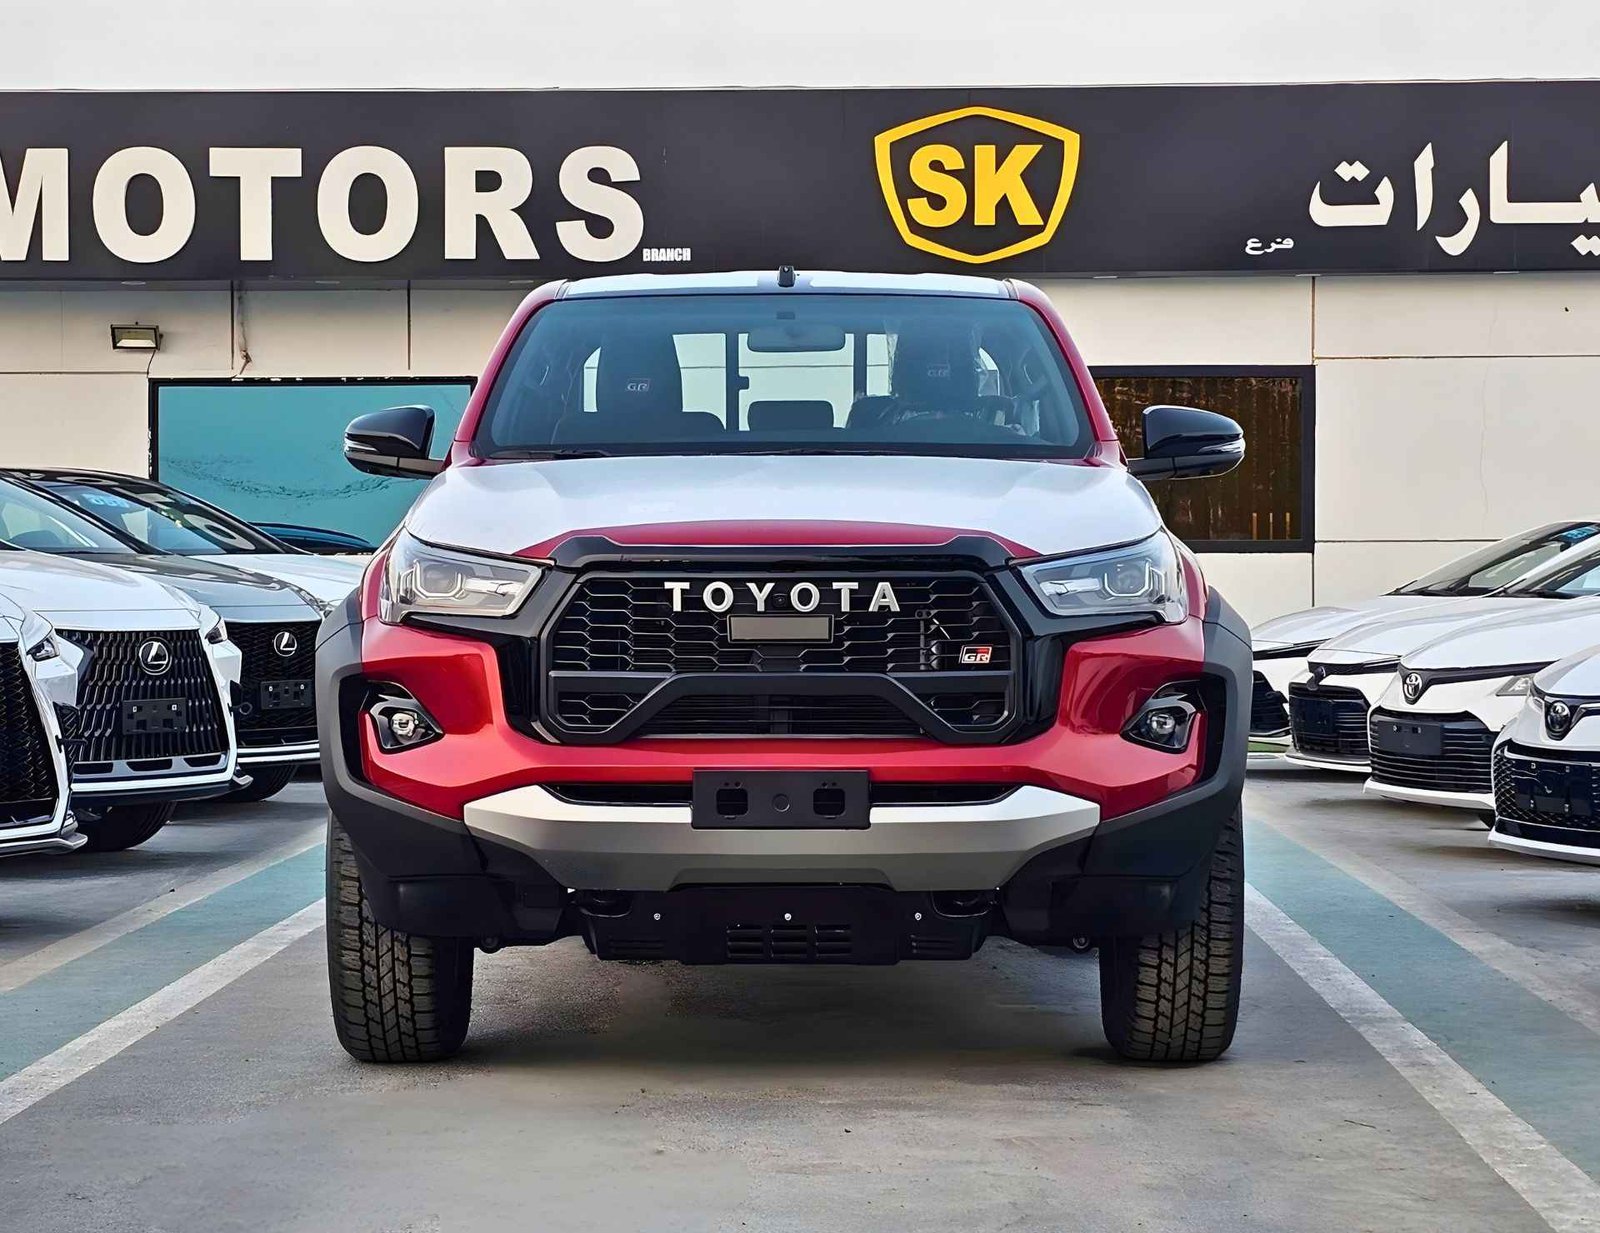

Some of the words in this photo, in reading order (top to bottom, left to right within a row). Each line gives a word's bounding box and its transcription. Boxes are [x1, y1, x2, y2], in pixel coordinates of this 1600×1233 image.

[0, 146, 645, 263] MOTORS
[907, 144, 1045, 227] SK
[1309, 141, 1600, 257] يارات
[643, 247, 691, 262] BRANCH
[1245, 238, 1294, 255] فرع
[664, 581, 900, 612] TOYOTA
